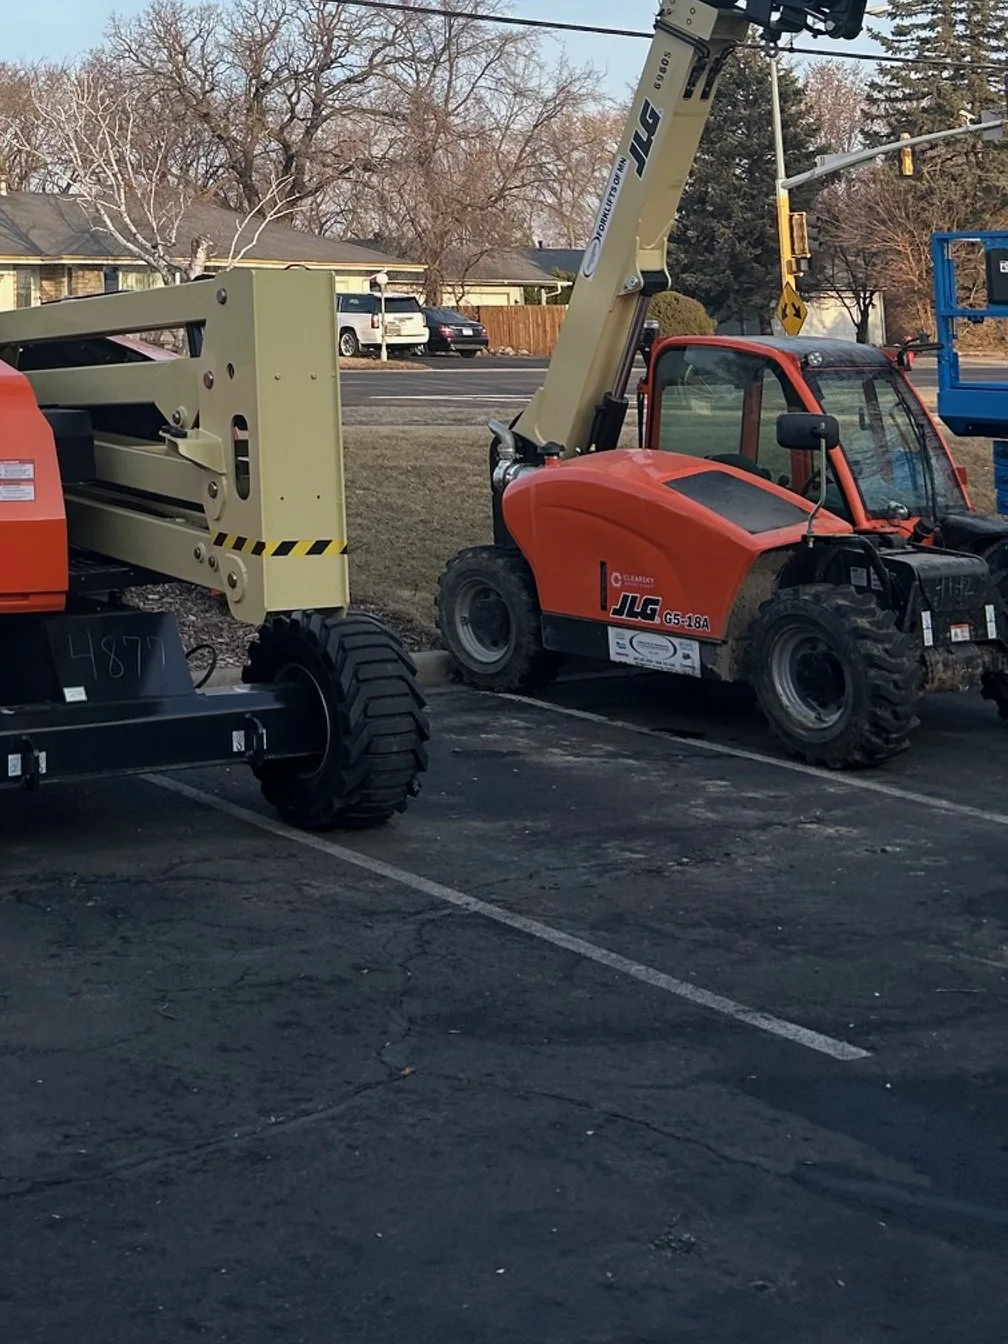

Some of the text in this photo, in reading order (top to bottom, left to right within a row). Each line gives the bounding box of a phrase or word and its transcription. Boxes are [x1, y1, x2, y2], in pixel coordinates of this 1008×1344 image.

[627, 97, 663, 180] JLG
[596, 157, 627, 238] FORKLIFTS OF MN
[610, 592, 710, 632] JLG G5-18A
[68, 628, 166, 681] 4877
